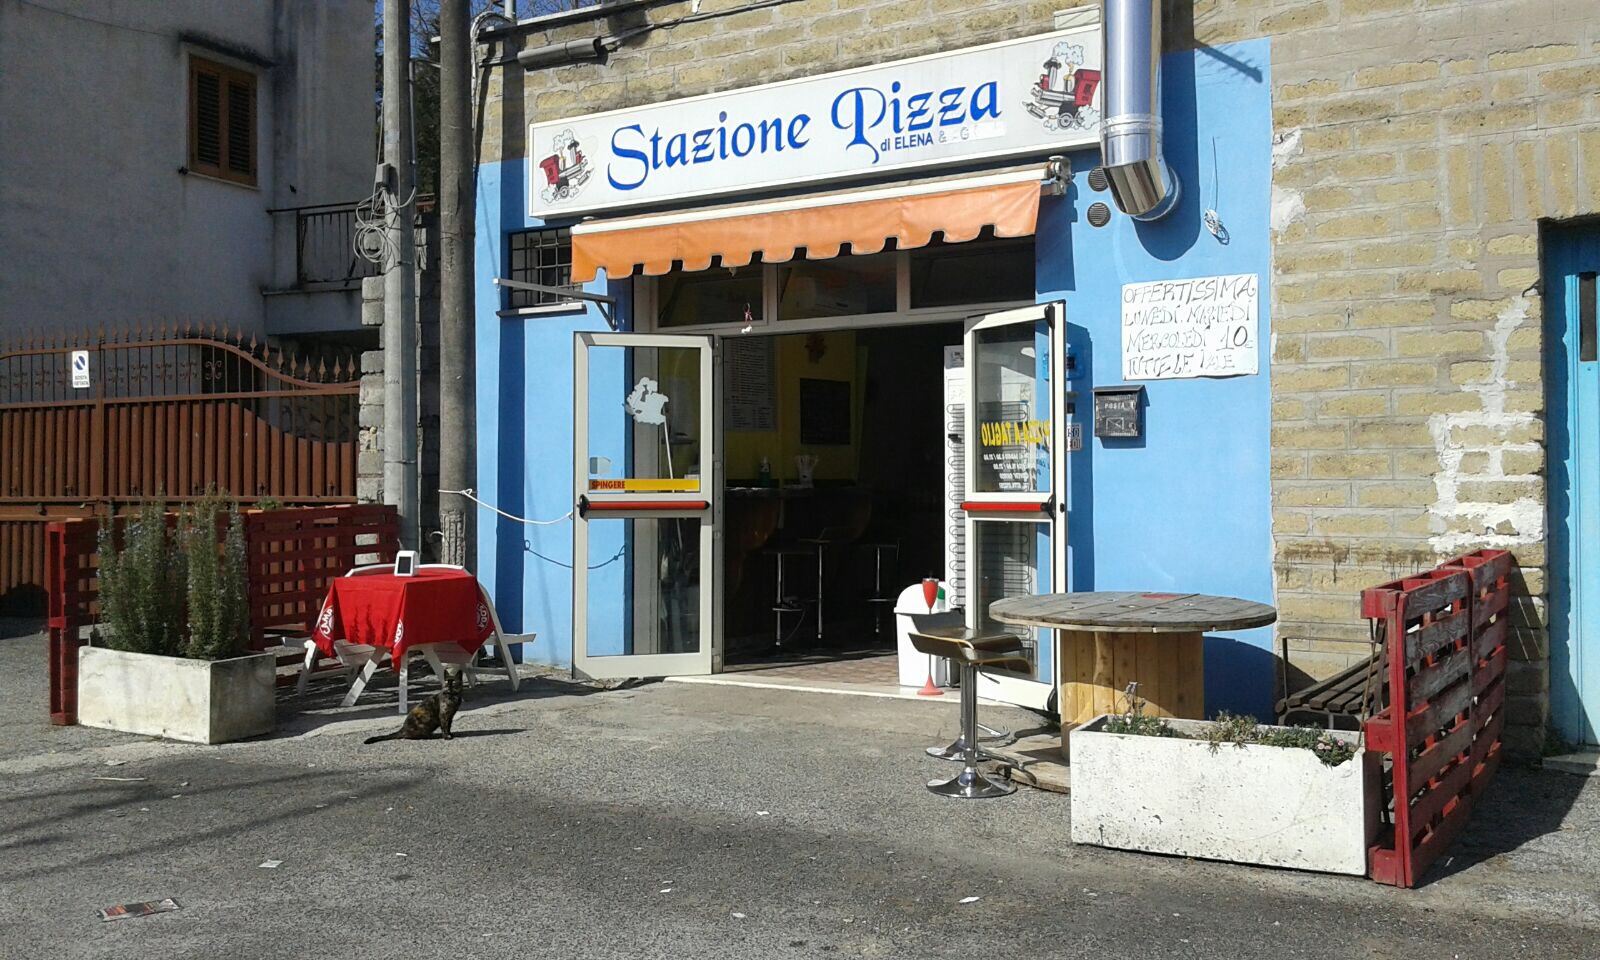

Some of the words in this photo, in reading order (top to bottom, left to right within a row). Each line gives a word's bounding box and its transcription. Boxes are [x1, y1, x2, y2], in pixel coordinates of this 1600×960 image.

[607, 111, 811, 191] Stazione
[831, 80, 1003, 165] Pizza
[880, 139, 891, 152] di
[894, 132, 934, 150] ELENA
[1104, 401, 1125, 410] POSTA
[591, 480, 626, 490] SPINGERE
